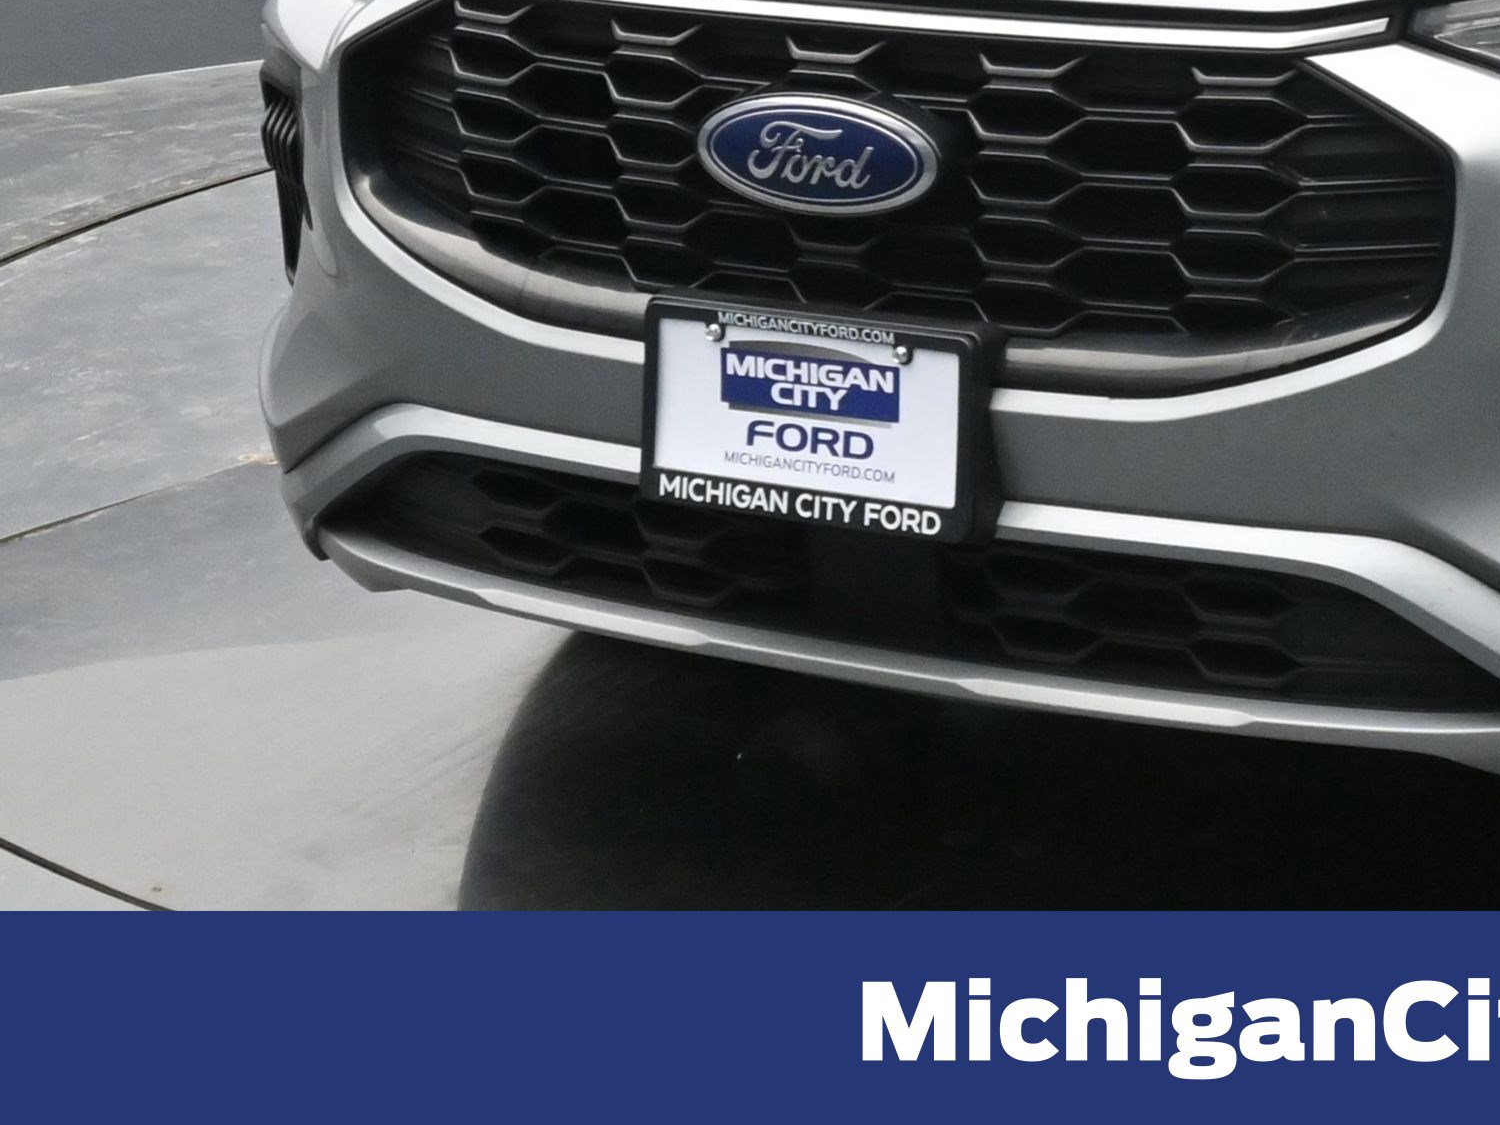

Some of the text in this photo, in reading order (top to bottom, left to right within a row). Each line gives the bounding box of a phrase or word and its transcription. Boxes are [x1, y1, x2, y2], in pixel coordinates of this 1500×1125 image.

[747, 120, 875, 189] Ford
[717, 311, 895, 344] MICHIGANCITYFORD.COM
[725, 353, 894, 393] MICHIGAN
[770, 382, 847, 411] CITY
[746, 419, 874, 460] FORD
[723, 450, 895, 484] MICHIGANCITYFORD.COM
[659, 474, 942, 536] MICHIGAN CITY FORD
